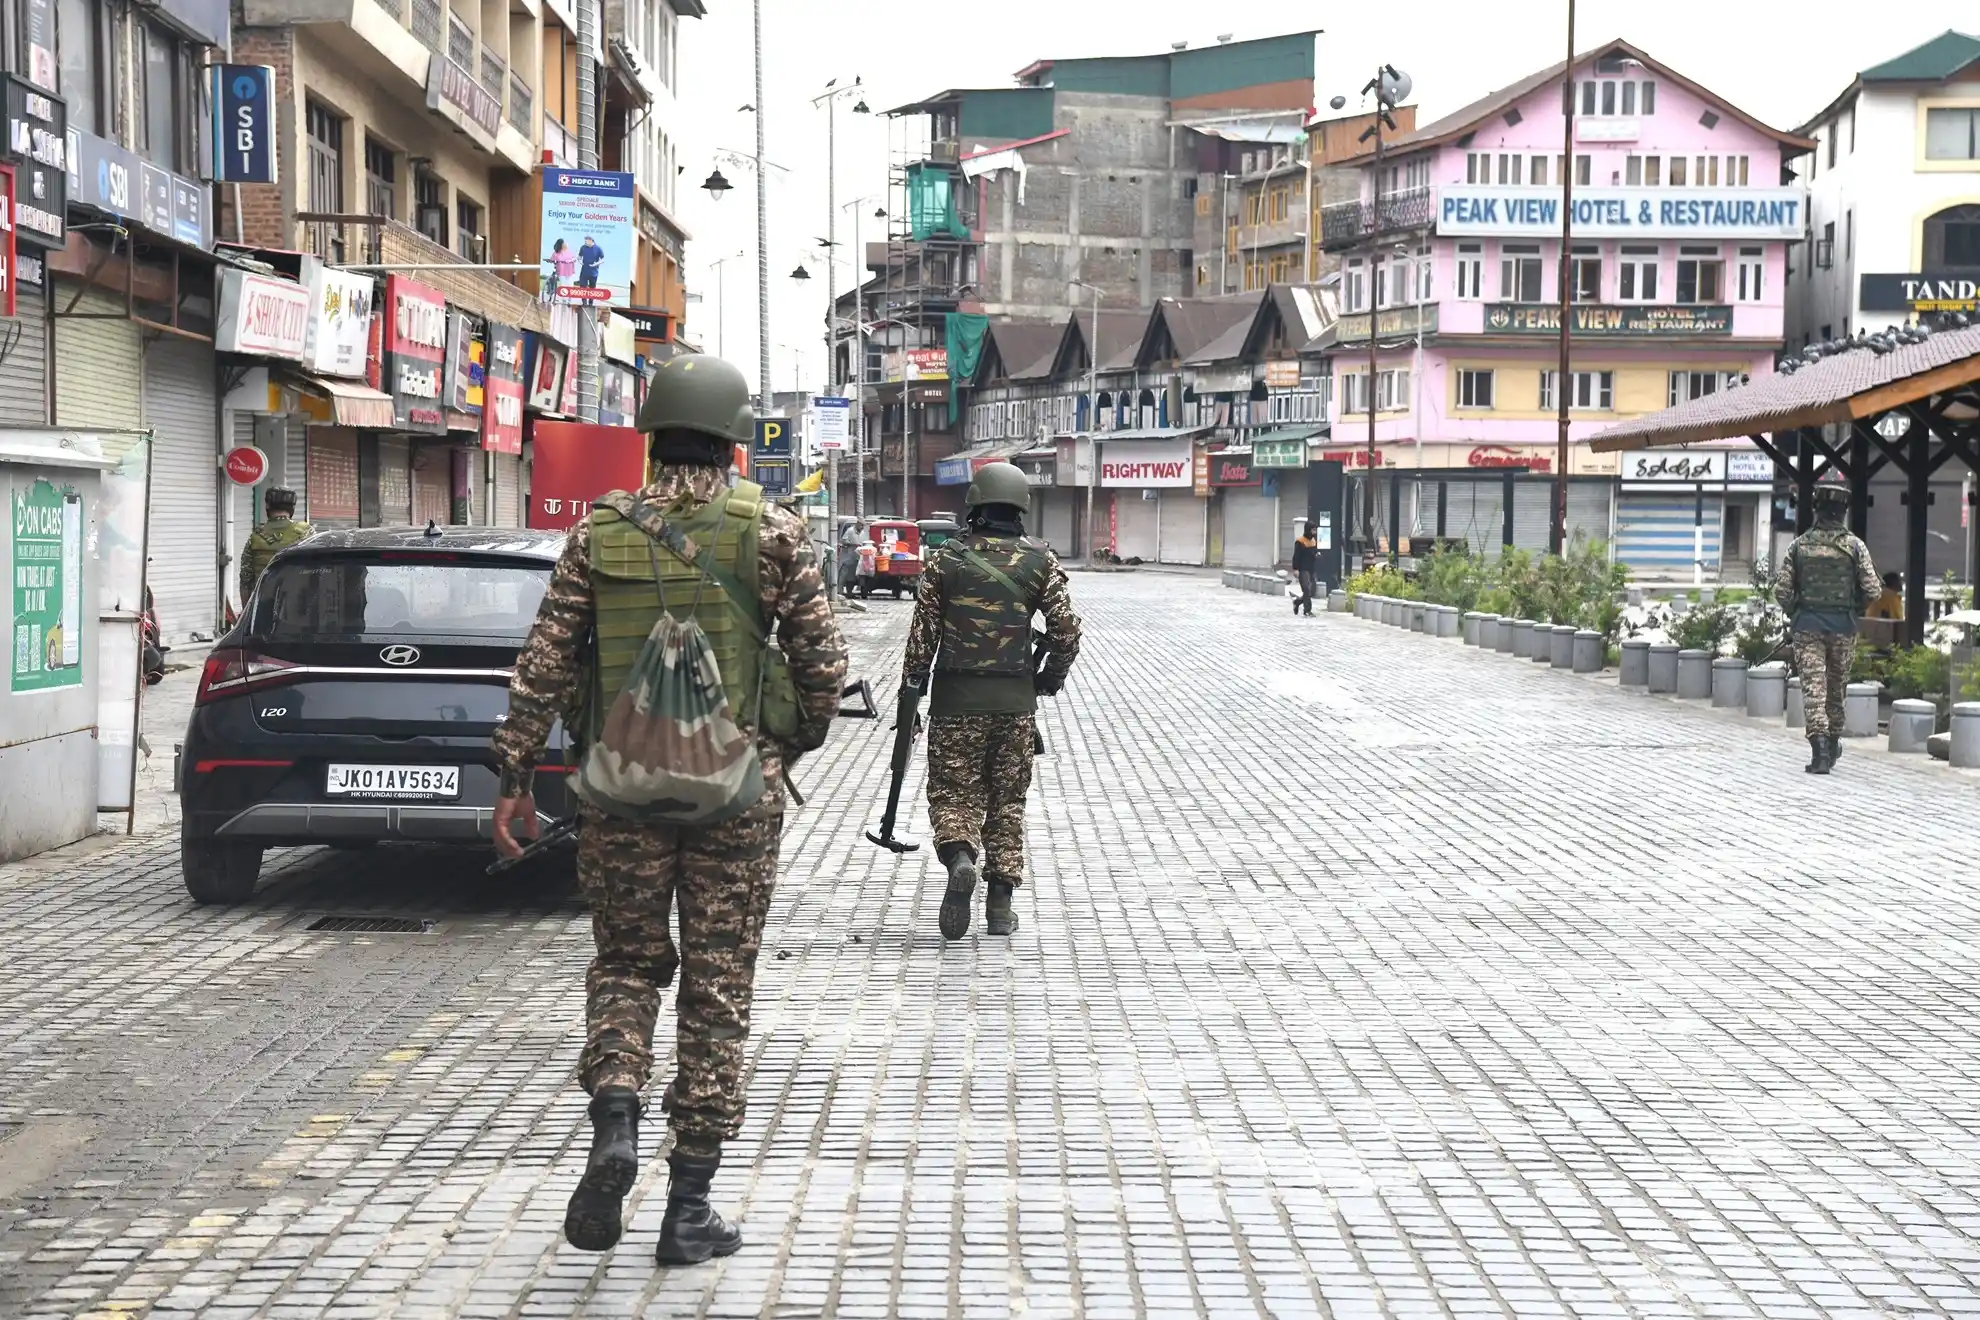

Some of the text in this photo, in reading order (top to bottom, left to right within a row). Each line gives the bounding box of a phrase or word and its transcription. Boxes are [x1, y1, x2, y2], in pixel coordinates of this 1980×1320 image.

[237, 105, 254, 174] SBI
[110, 162, 128, 210] SBI
[594, 179, 616, 187] BANK
[548, 210, 566, 219] Enjoy
[584, 212, 608, 220] Golden
[1443, 198, 1798, 226] PEAK VIEW HOTEL & RESTAURANT
[1901, 280, 1980, 300] TAND
[253, 293, 283, 337] SHOE
[283, 300, 306, 341] CITY
[1514, 310, 1624, 329] PEAK VIEW
[1628, 319, 1726, 329] RESTAURANT
[1647, 310, 1695, 319] HOTEL
[915, 352, 929, 362] eat
[764, 422, 781, 446] P
[1102, 462, 1185, 478] RIGHTWAY
[1220, 462, 1250, 480] Bata
[40, 506, 62, 536] CABS
[339, 769, 455, 790] JK01AV5634
